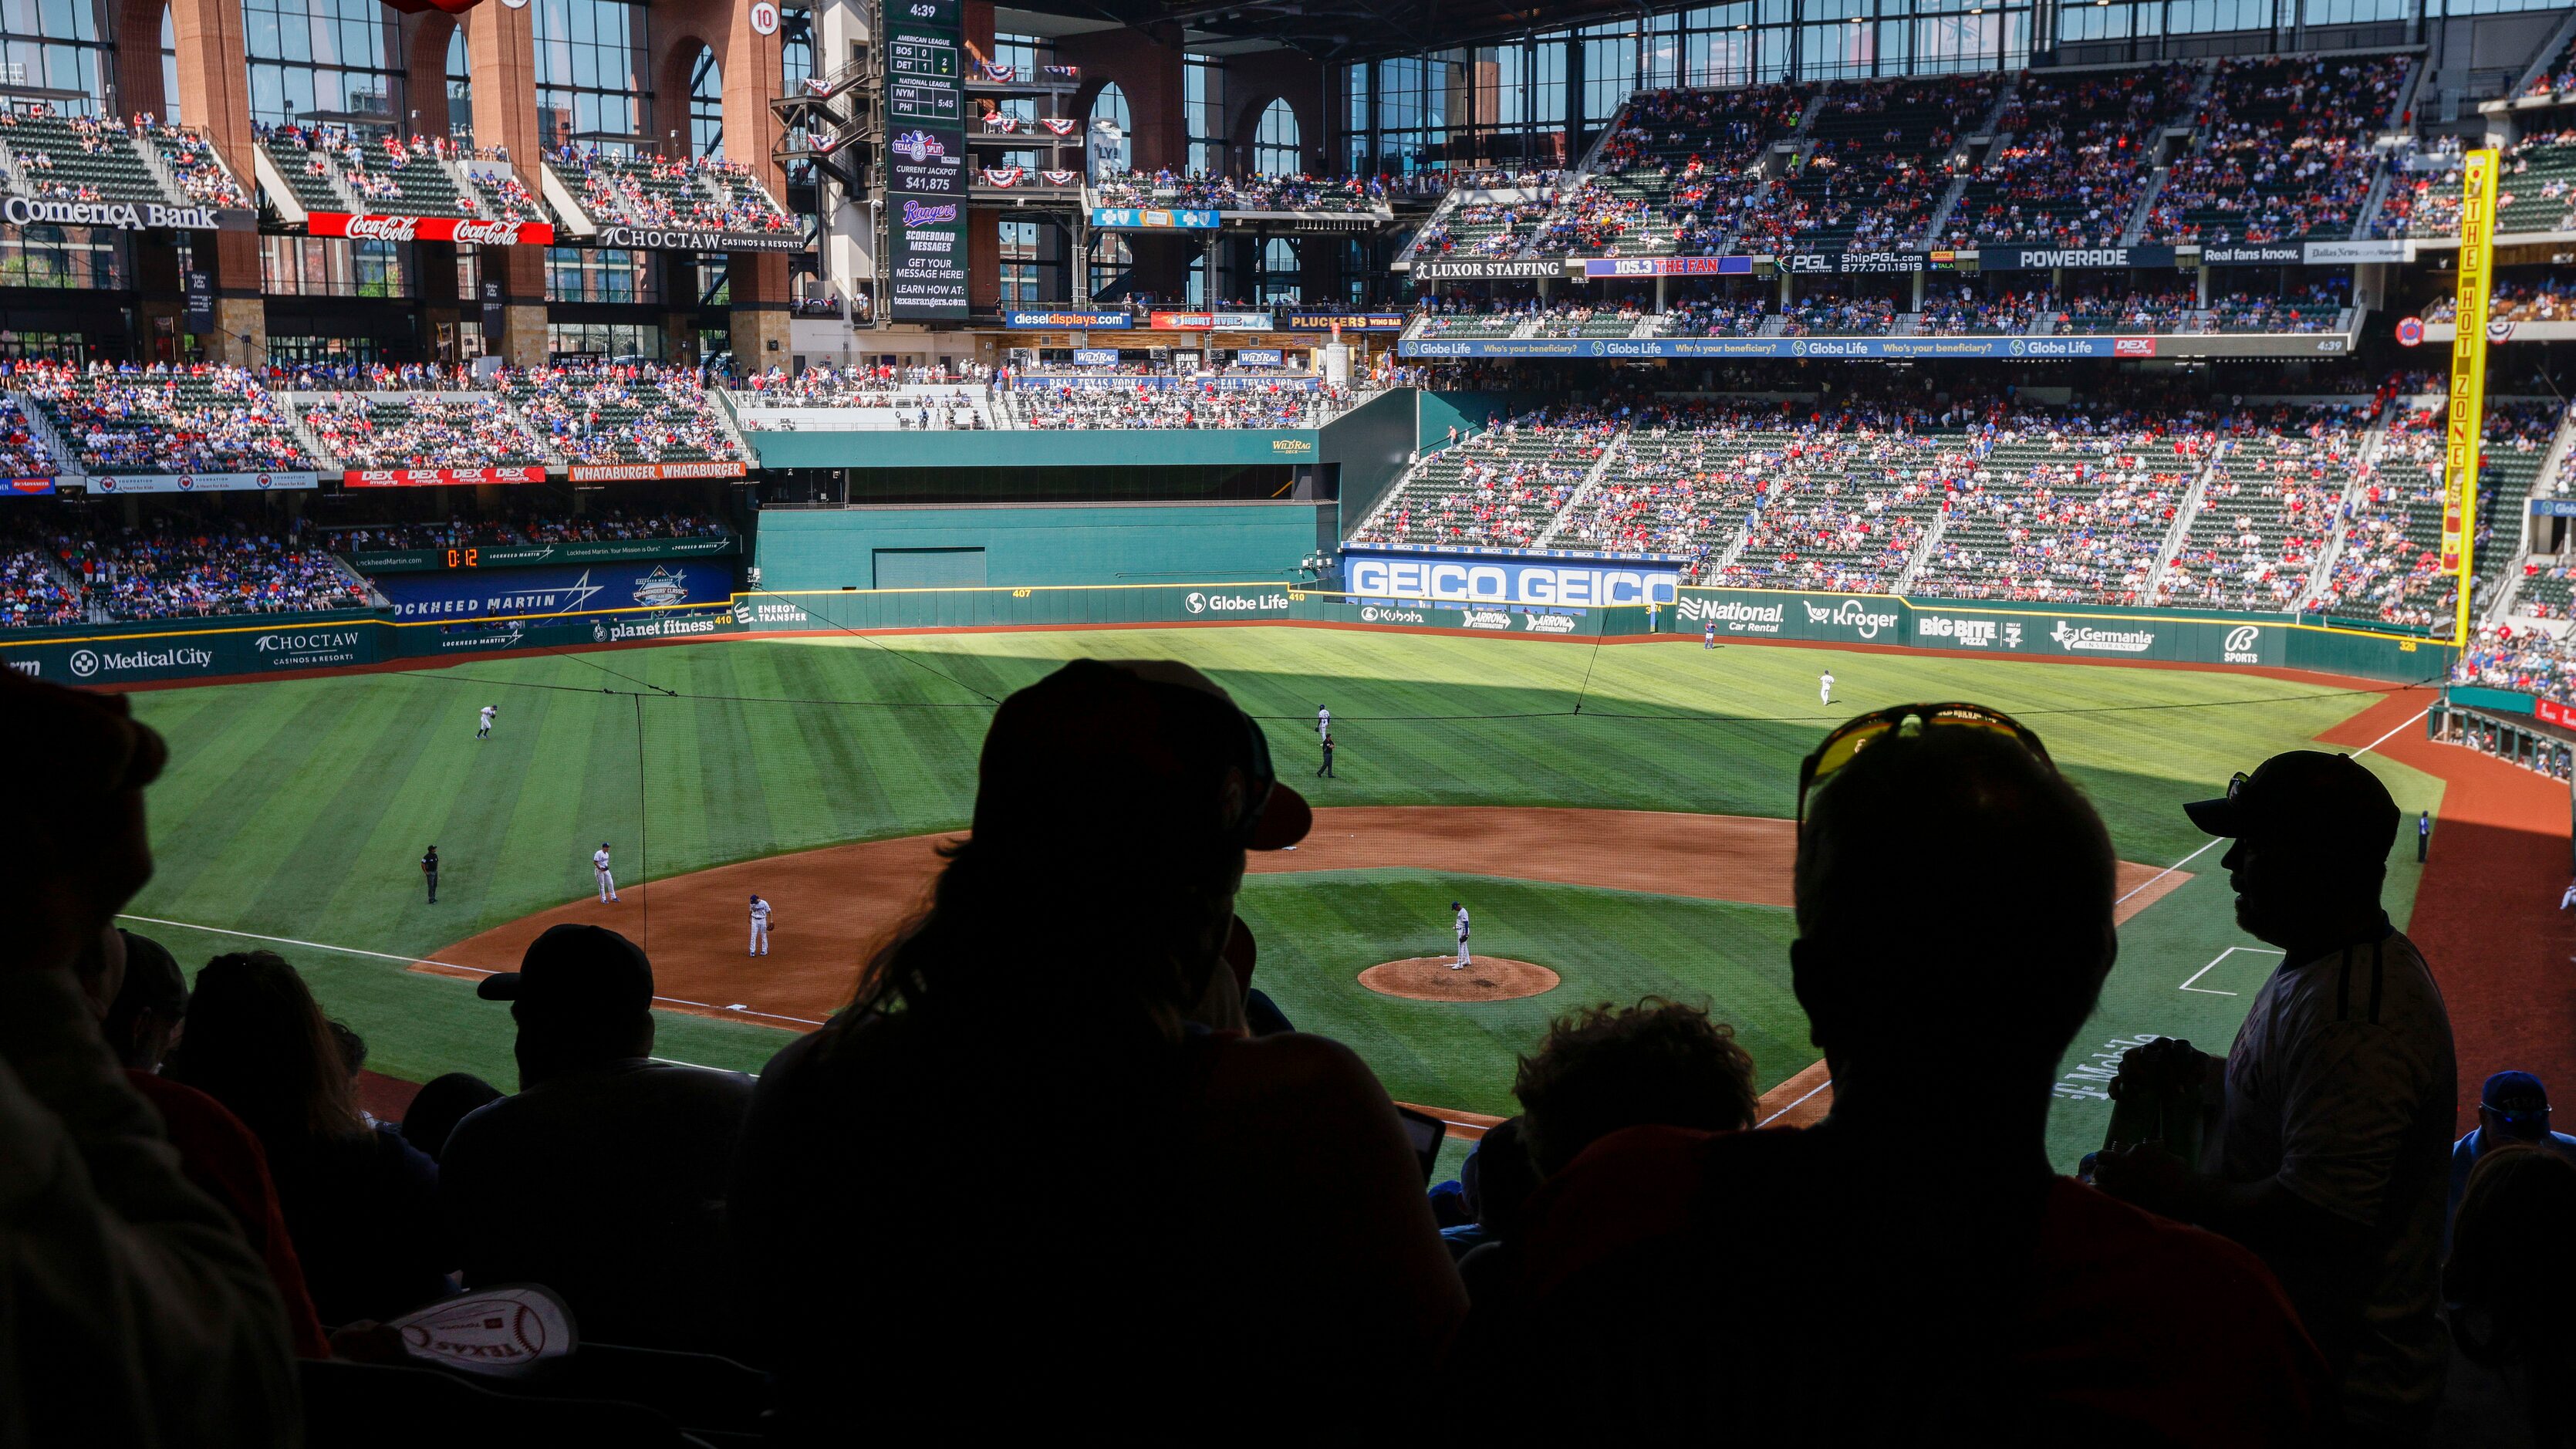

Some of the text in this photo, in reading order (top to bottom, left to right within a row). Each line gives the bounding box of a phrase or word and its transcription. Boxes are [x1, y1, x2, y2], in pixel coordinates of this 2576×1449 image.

[910, 4, 935, 17] 4:39
[757, 9, 772, 28] 10
[897, 35, 926, 43] AMERICAN
[896, 46, 912, 56] BOS
[896, 61, 913, 69] DET
[896, 89, 914, 97] NYM
[899, 99, 954, 112] PHI 5:45
[895, 143, 941, 154] TEXAS SPLIT
[896, 165, 957, 176] CURRENT JACKPOT
[906, 176, 950, 191] $41,875
[147, 204, 218, 229] Bank
[903, 201, 956, 226] Rangers
[346, 214, 418, 241] Coca-Cola
[453, 218, 522, 245] Coca-Cola
[615, 227, 721, 249] CHOCTAW
[722, 238, 758, 247] CASINOS
[906, 231, 955, 242] SCOREBOARD
[2466, 201, 2479, 268] THE
[910, 242, 951, 252] MESSAGES
[2205, 248, 2299, 261] Real fans know.
[908, 258, 951, 268] GET YOUR
[1615, 258, 1718, 274] 105.3 THE FAN
[1792, 252, 1923, 269] PGL ShipPGL.com
[1431, 262, 1559, 277] LUXOR STAFFING
[1842, 263, 1923, 272] 877.701.1919
[896, 269, 964, 279] MESSAGE HERE!
[896, 285, 964, 295] LEARN HOW AT:
[894, 296, 966, 307] texasrangers.com
[1015, 313, 1123, 326] dieseldisplays.com
[1184, 317, 1242, 326] HART HVAC
[1291, 317, 1366, 327] PLUCKERS
[2460, 289, 2473, 355] HOT
[1420, 343, 1578, 354] Globe Life Who's your beneficiary?
[1607, 343, 1776, 354] Globe Life Who's your beneficiary?
[1809, 343, 1992, 354] Globe Life Who's your beneficiary?
[2028, 342, 2092, 353] Globe Life
[2117, 340, 2149, 349] DEX
[2318, 341, 2342, 350] 4:39
[1077, 351, 1116, 362] WILD RAG
[1242, 352, 1278, 362] WILD RAG
[1214, 379, 1238, 390] REAL
[2454, 377, 2467, 464] ZONE
[1273, 439, 1311, 449] WILD RAG
[362, 471, 395, 481] DEX
[407, 469, 440, 479] DEX
[452, 468, 484, 478] DEX
[496, 468, 528, 478] DEX
[447, 549, 477, 568] 0:12
[1353, 561, 1678, 605] GEICO GEICO
[1013, 589, 1031, 598] 407
[488, 595, 555, 610] MARTIN
[1210, 594, 1288, 610] Globe Life
[758, 604, 796, 613] ENERGY
[715, 616, 731, 625] 410
[758, 613, 807, 622] TRANSFER
[1380, 609, 1424, 623] Kubota
[1475, 612, 1507, 623] ARROW
[1538, 615, 1568, 626] ARROW
[1833, 600, 1898, 639] Kroger
[610, 619, 714, 640] planet fitness
[2080, 627, 2152, 644] Germania
[266, 633, 358, 650] CHOCTAW
[1960, 637, 1988, 646] PIZZA
[2399, 641, 2416, 652] 326
[103, 648, 212, 670] Medical City
[274, 657, 309, 665] CASINOS
[2224, 652, 2257, 664] SPORTS
[437, 1341, 525, 1358] TEXAS
